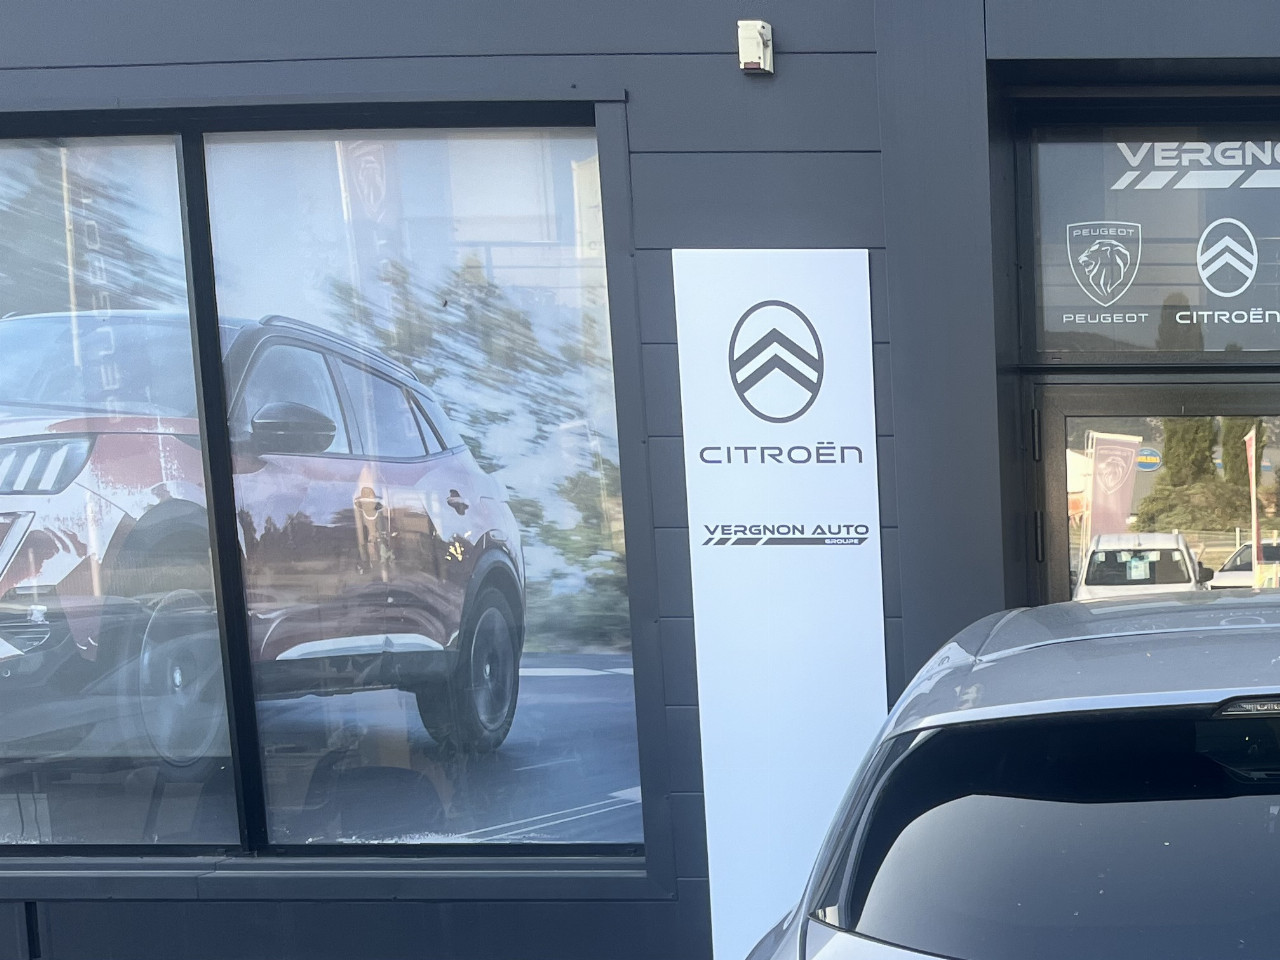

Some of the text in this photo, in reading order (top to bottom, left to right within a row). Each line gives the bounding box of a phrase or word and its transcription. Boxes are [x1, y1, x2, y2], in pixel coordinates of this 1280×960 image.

[1072, 228, 1136, 238] PEUGEOT
[1063, 313, 1149, 323] PEUGEOT
[704, 524, 869, 536] VERGNON AUTO
